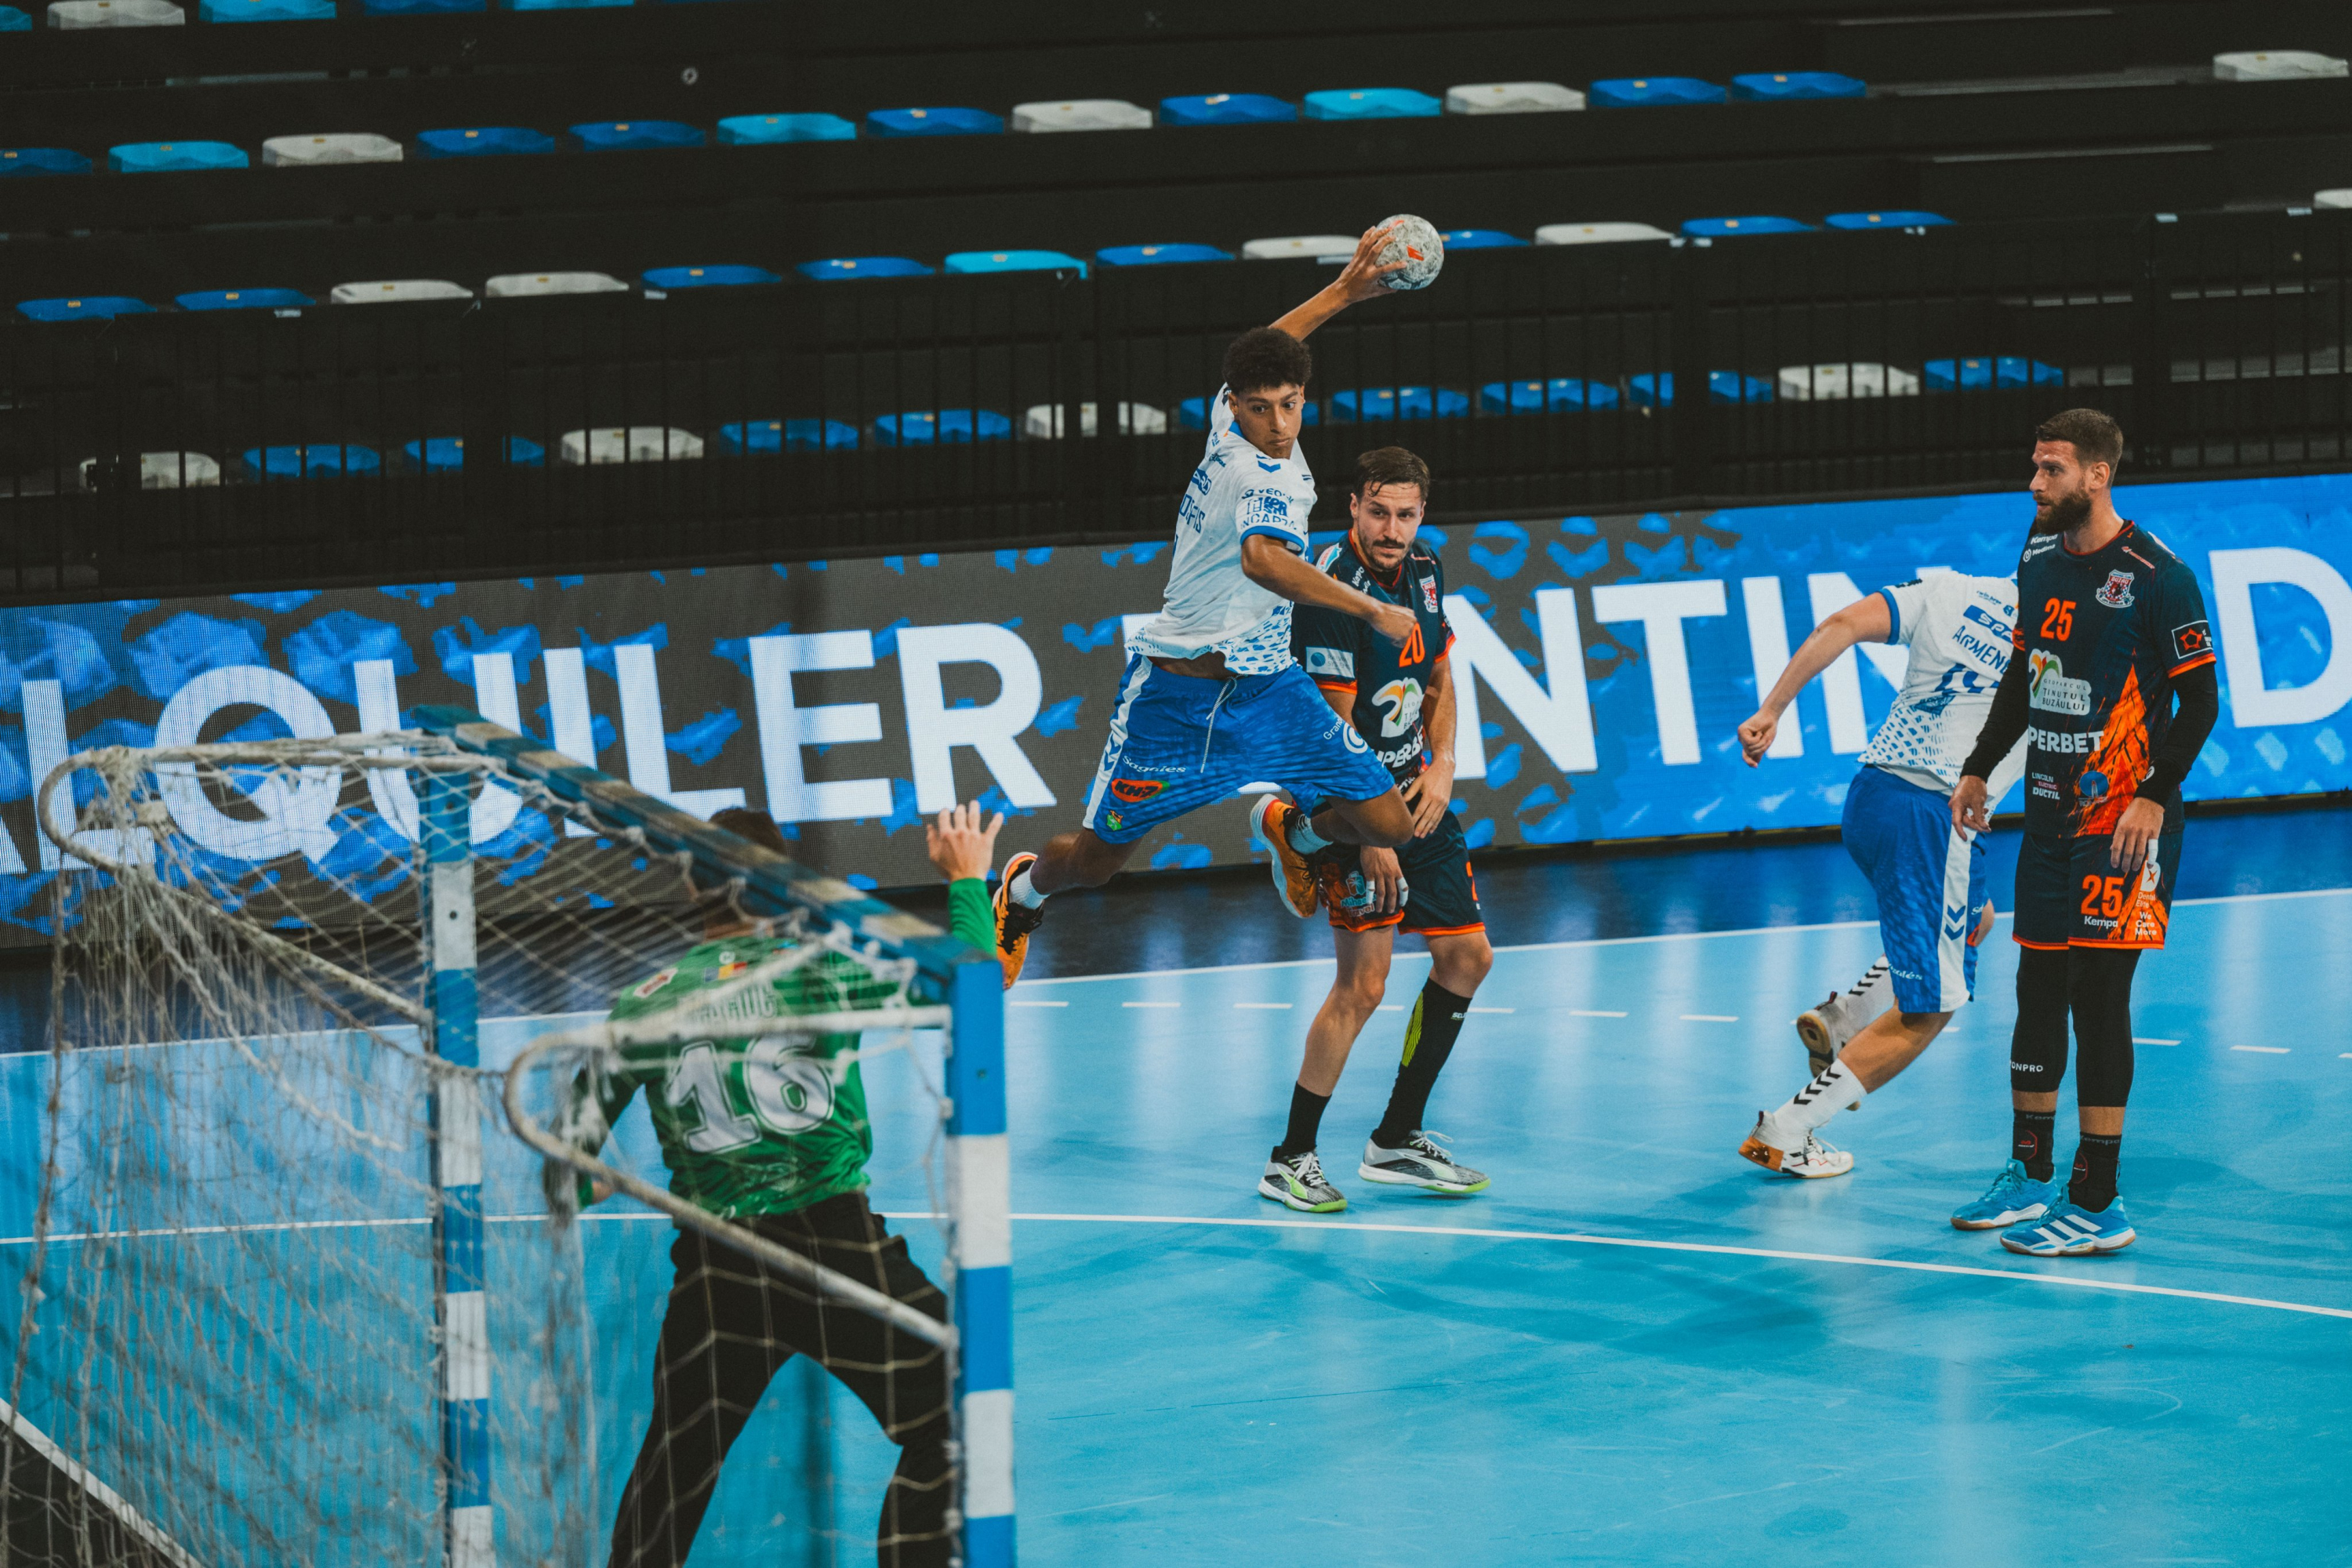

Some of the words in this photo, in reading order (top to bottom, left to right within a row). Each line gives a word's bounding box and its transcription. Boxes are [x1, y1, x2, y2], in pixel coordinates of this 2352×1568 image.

[2031, 534, 2058, 545] Kempa
[2040, 597, 2077, 641] 25
[1399, 622, 1425, 668] 20
[0, 622, 1057, 875] LQUILER
[2209, 546, 2352, 728] D
[2028, 724, 2104, 753] PERBET
[2032, 786, 2060, 800] DUCTIL
[2081, 874, 2125, 918] 25
[2137, 892, 2156, 901] Dental
[2136, 899, 2149, 908] Elite
[2084, 915, 2118, 930] Kempa
[2140, 911, 2151, 920] We
[2135, 919, 2155, 927] Care
[2009, 1060, 2043, 1073] ONPRO
[665, 1032, 836, 1154] 16
